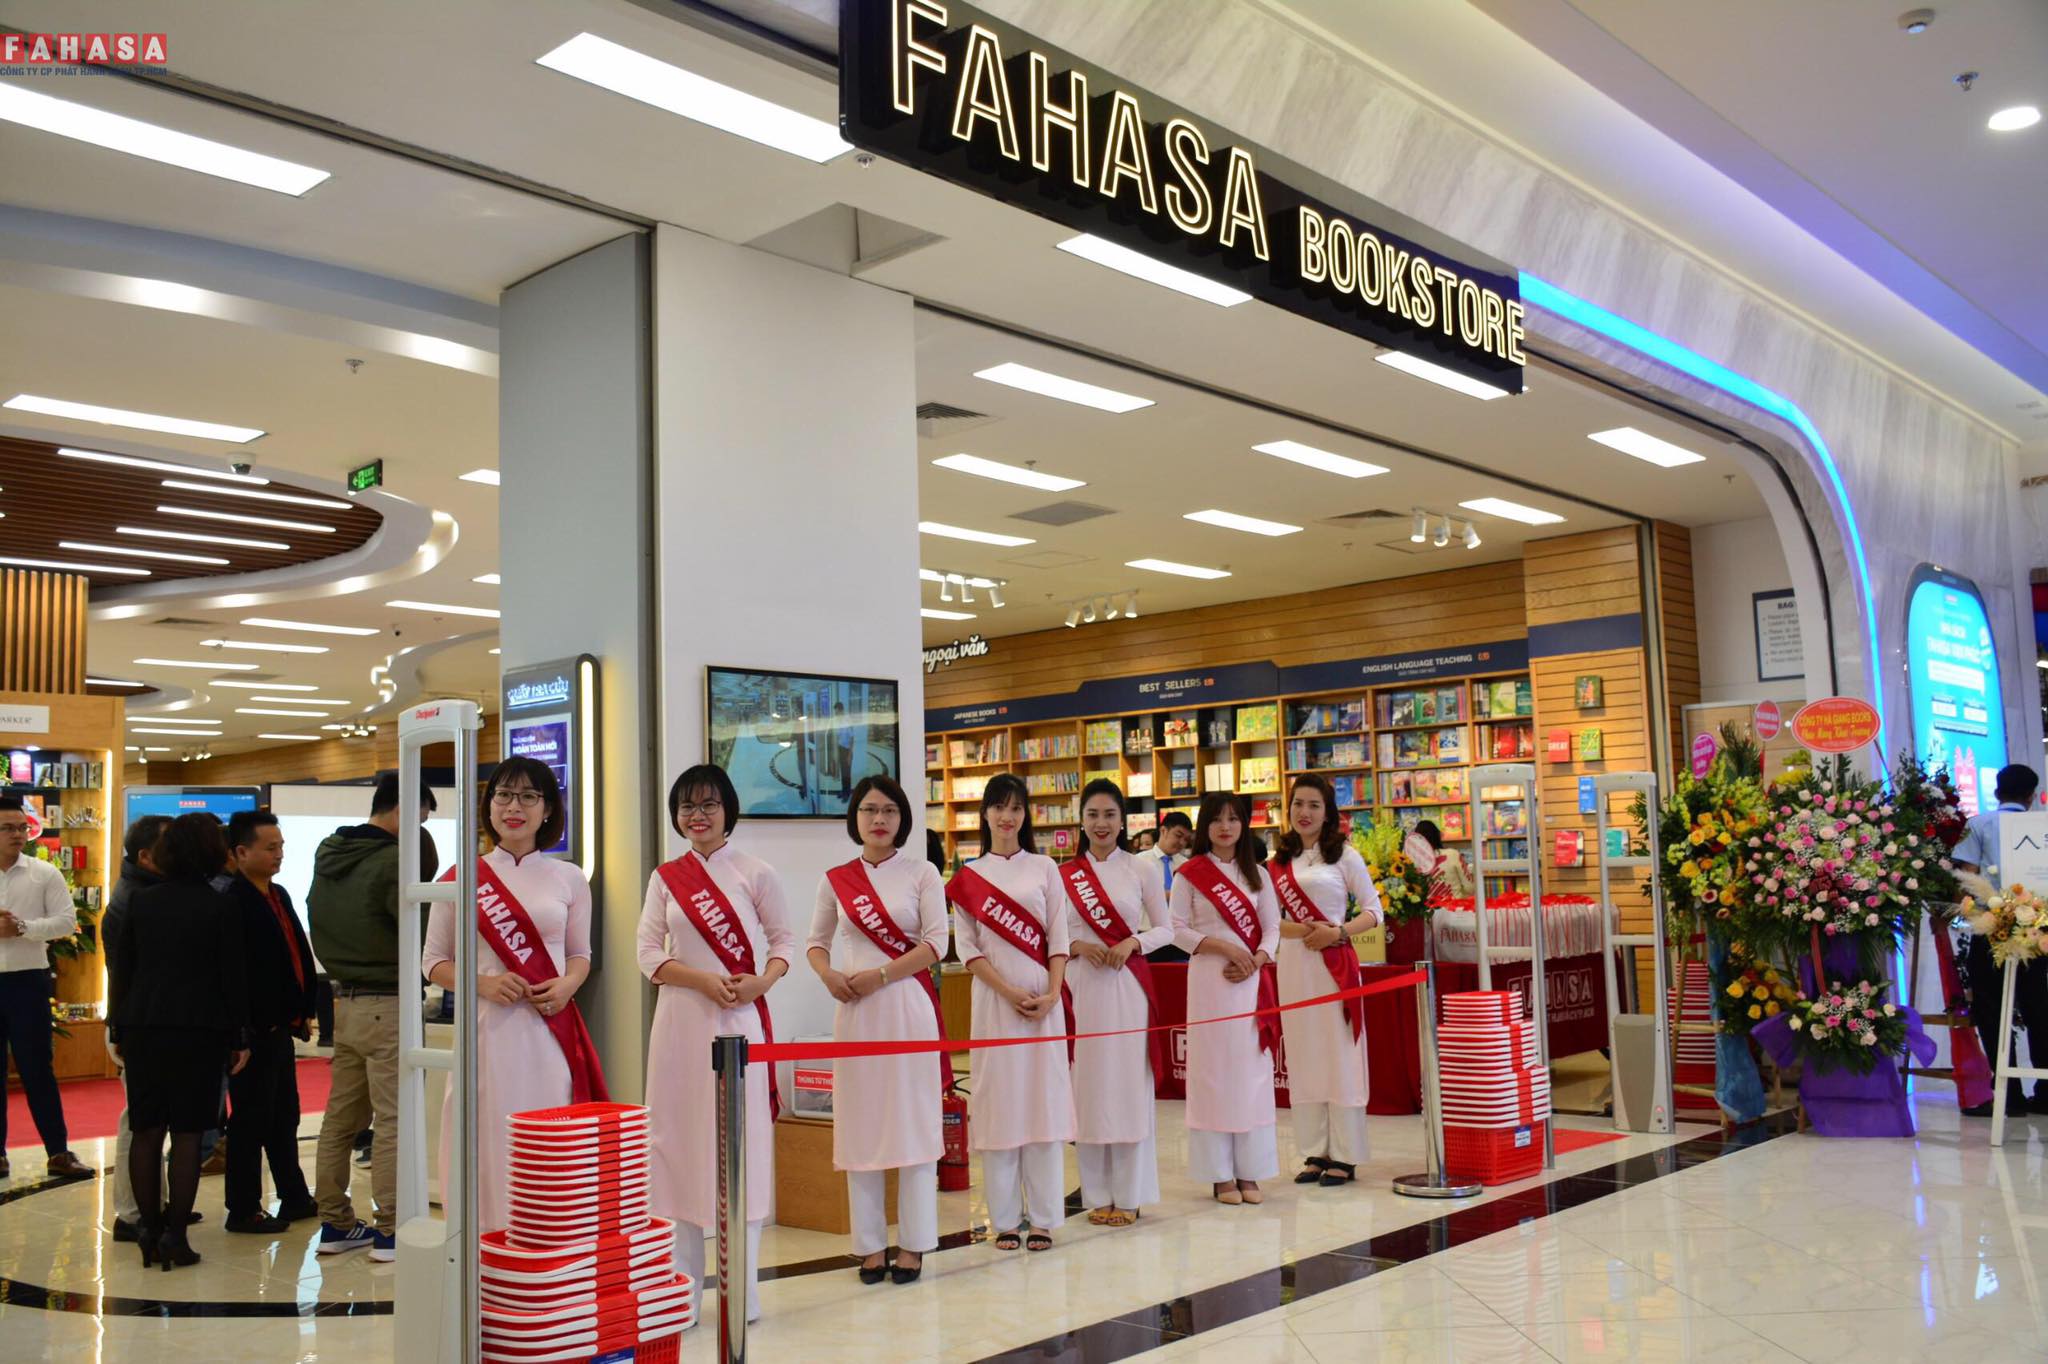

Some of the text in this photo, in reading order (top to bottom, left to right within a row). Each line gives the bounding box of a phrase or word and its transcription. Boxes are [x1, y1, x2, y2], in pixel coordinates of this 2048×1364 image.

[892, 0, 1526, 366] FAHASA BOOKSTORE
[960, 635, 988, 657] văn
[1362, 665, 1393, 674] ENGLISH
[1394, 659, 1434, 670] LANGUAGE
[1435, 654, 1473, 666] TEACHING
[1139, 678, 1201, 693] BEST SELLERS
[953, 708, 997, 720] JAPANESE BOOKS
[477, 882, 533, 965] FAHASA
[690, 889, 745, 962] FAHASA
[982, 896, 1041, 951] FAHASA
[1070, 869, 1112, 929] FAHASA
[1211, 883, 1255, 938] FAHASA
